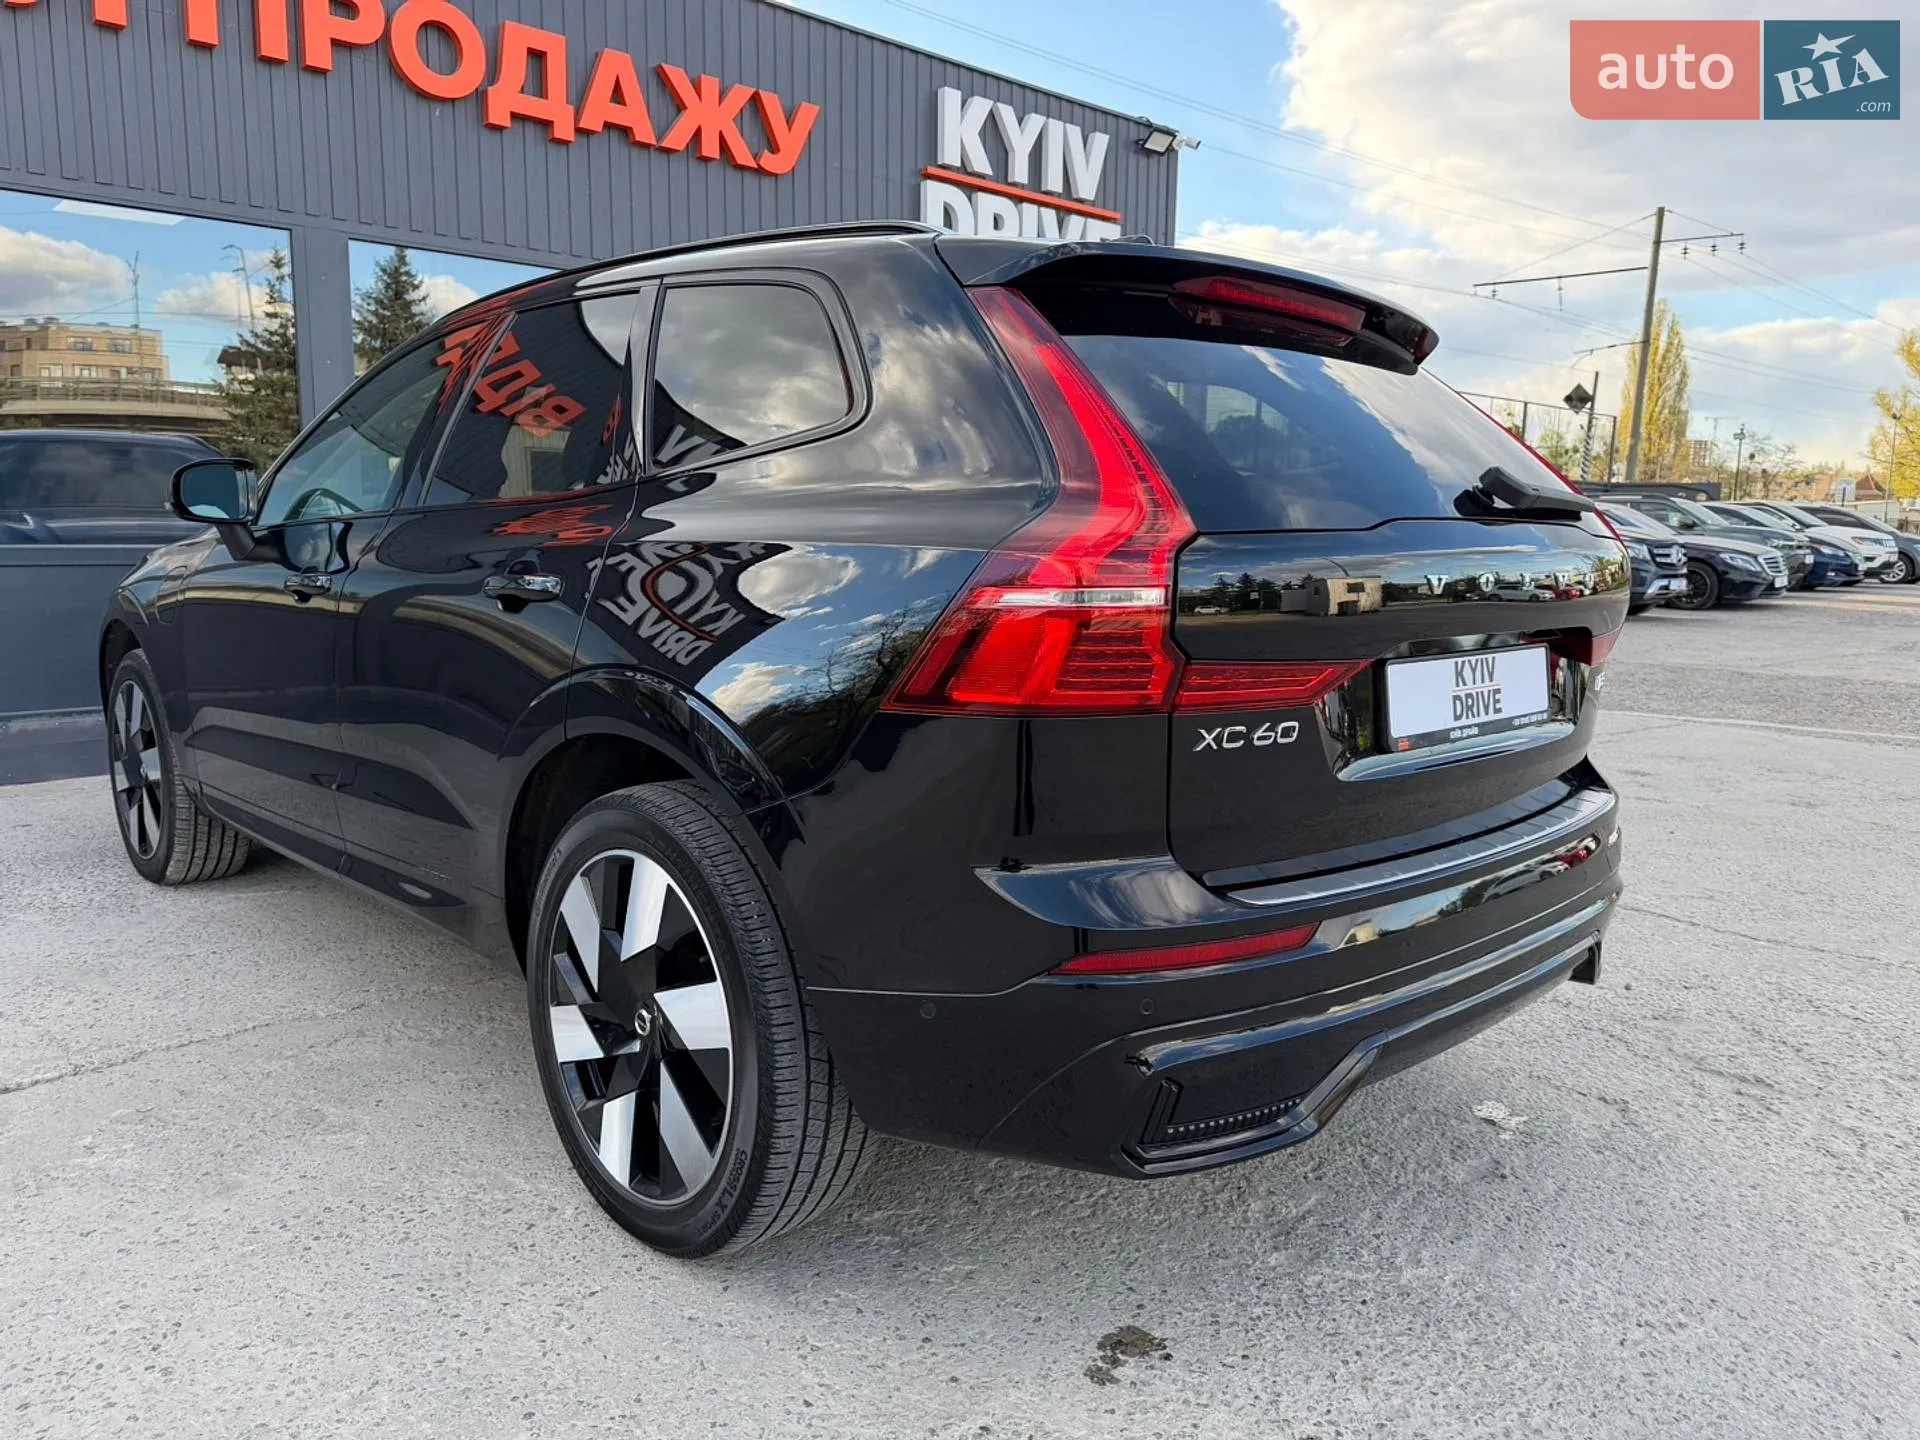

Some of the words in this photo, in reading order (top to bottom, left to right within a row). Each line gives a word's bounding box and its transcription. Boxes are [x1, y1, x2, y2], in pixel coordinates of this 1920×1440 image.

[937, 86, 1110, 201] KYIV
[1424, 572, 1595, 595] VOLVO
[1454, 656, 1497, 689] KYIV
[1452, 688, 1503, 722] DRIVE
